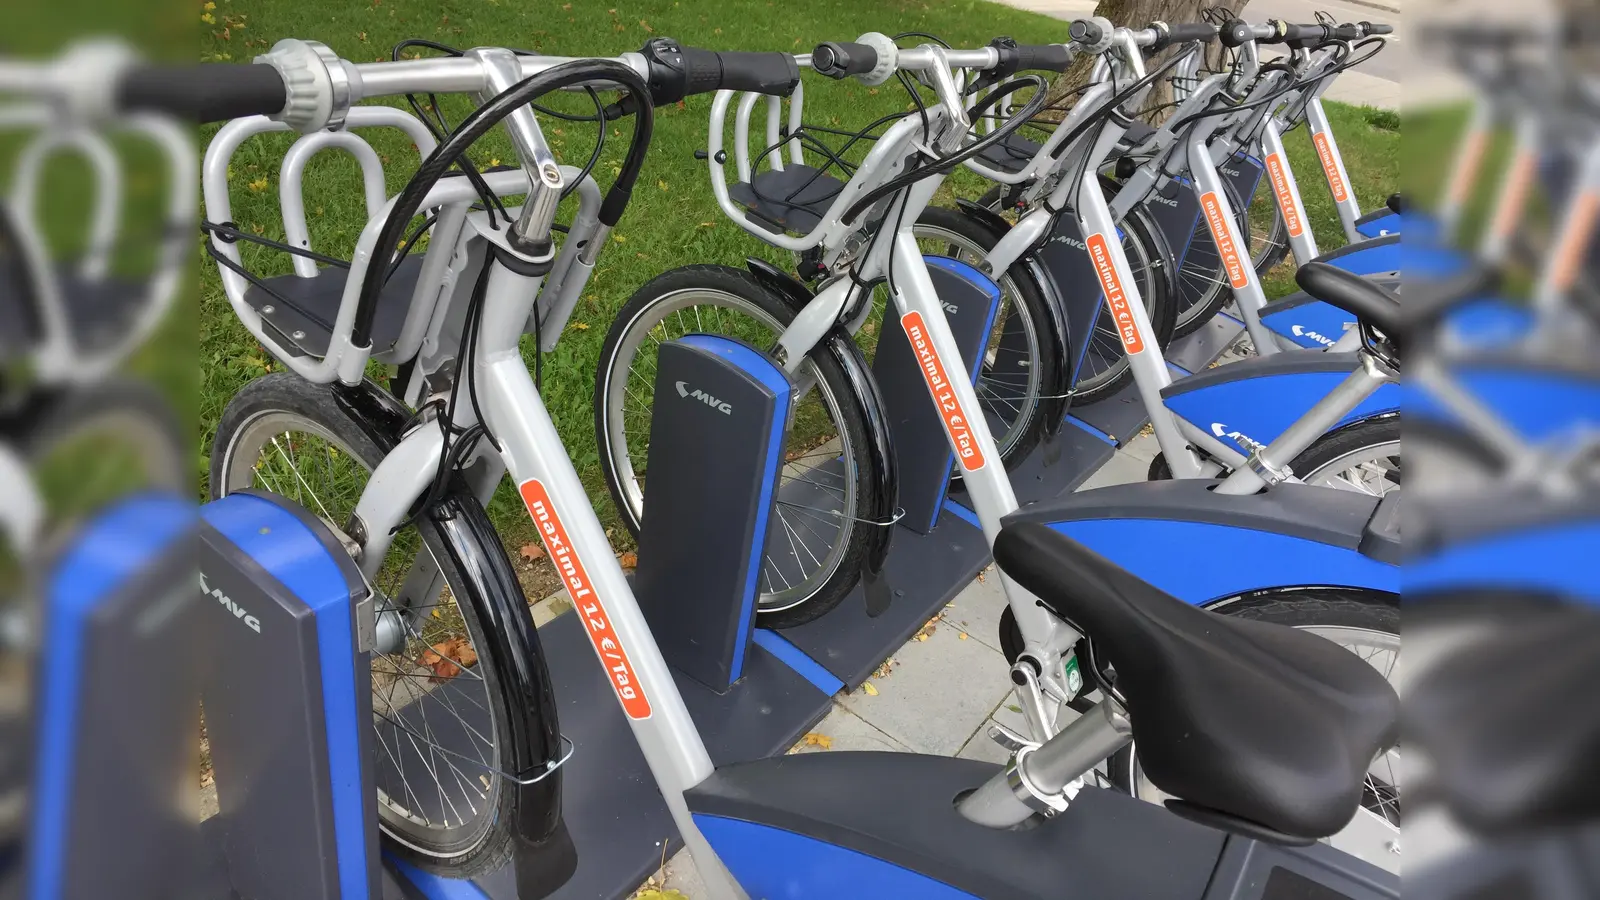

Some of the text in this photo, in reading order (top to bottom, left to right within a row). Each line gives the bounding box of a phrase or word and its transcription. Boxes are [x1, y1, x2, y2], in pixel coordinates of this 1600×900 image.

[1152, 195, 1178, 207] MVG
[1271, 161, 1289, 195] maximal
[1282, 195, 1291, 206] 12
[1057, 235, 1086, 251] MVG
[1206, 200, 1241, 281] maximal 12 €/Tag
[939, 299, 959, 315] VG
[1092, 244, 1137, 345] maximal 12 €/Tag
[690, 389, 732, 416] MVG
[909, 325, 975, 459] maximal 12 €/Tag
[211, 588, 261, 634] MVG
[532, 499, 637, 700] maximal 12 €/Tag
